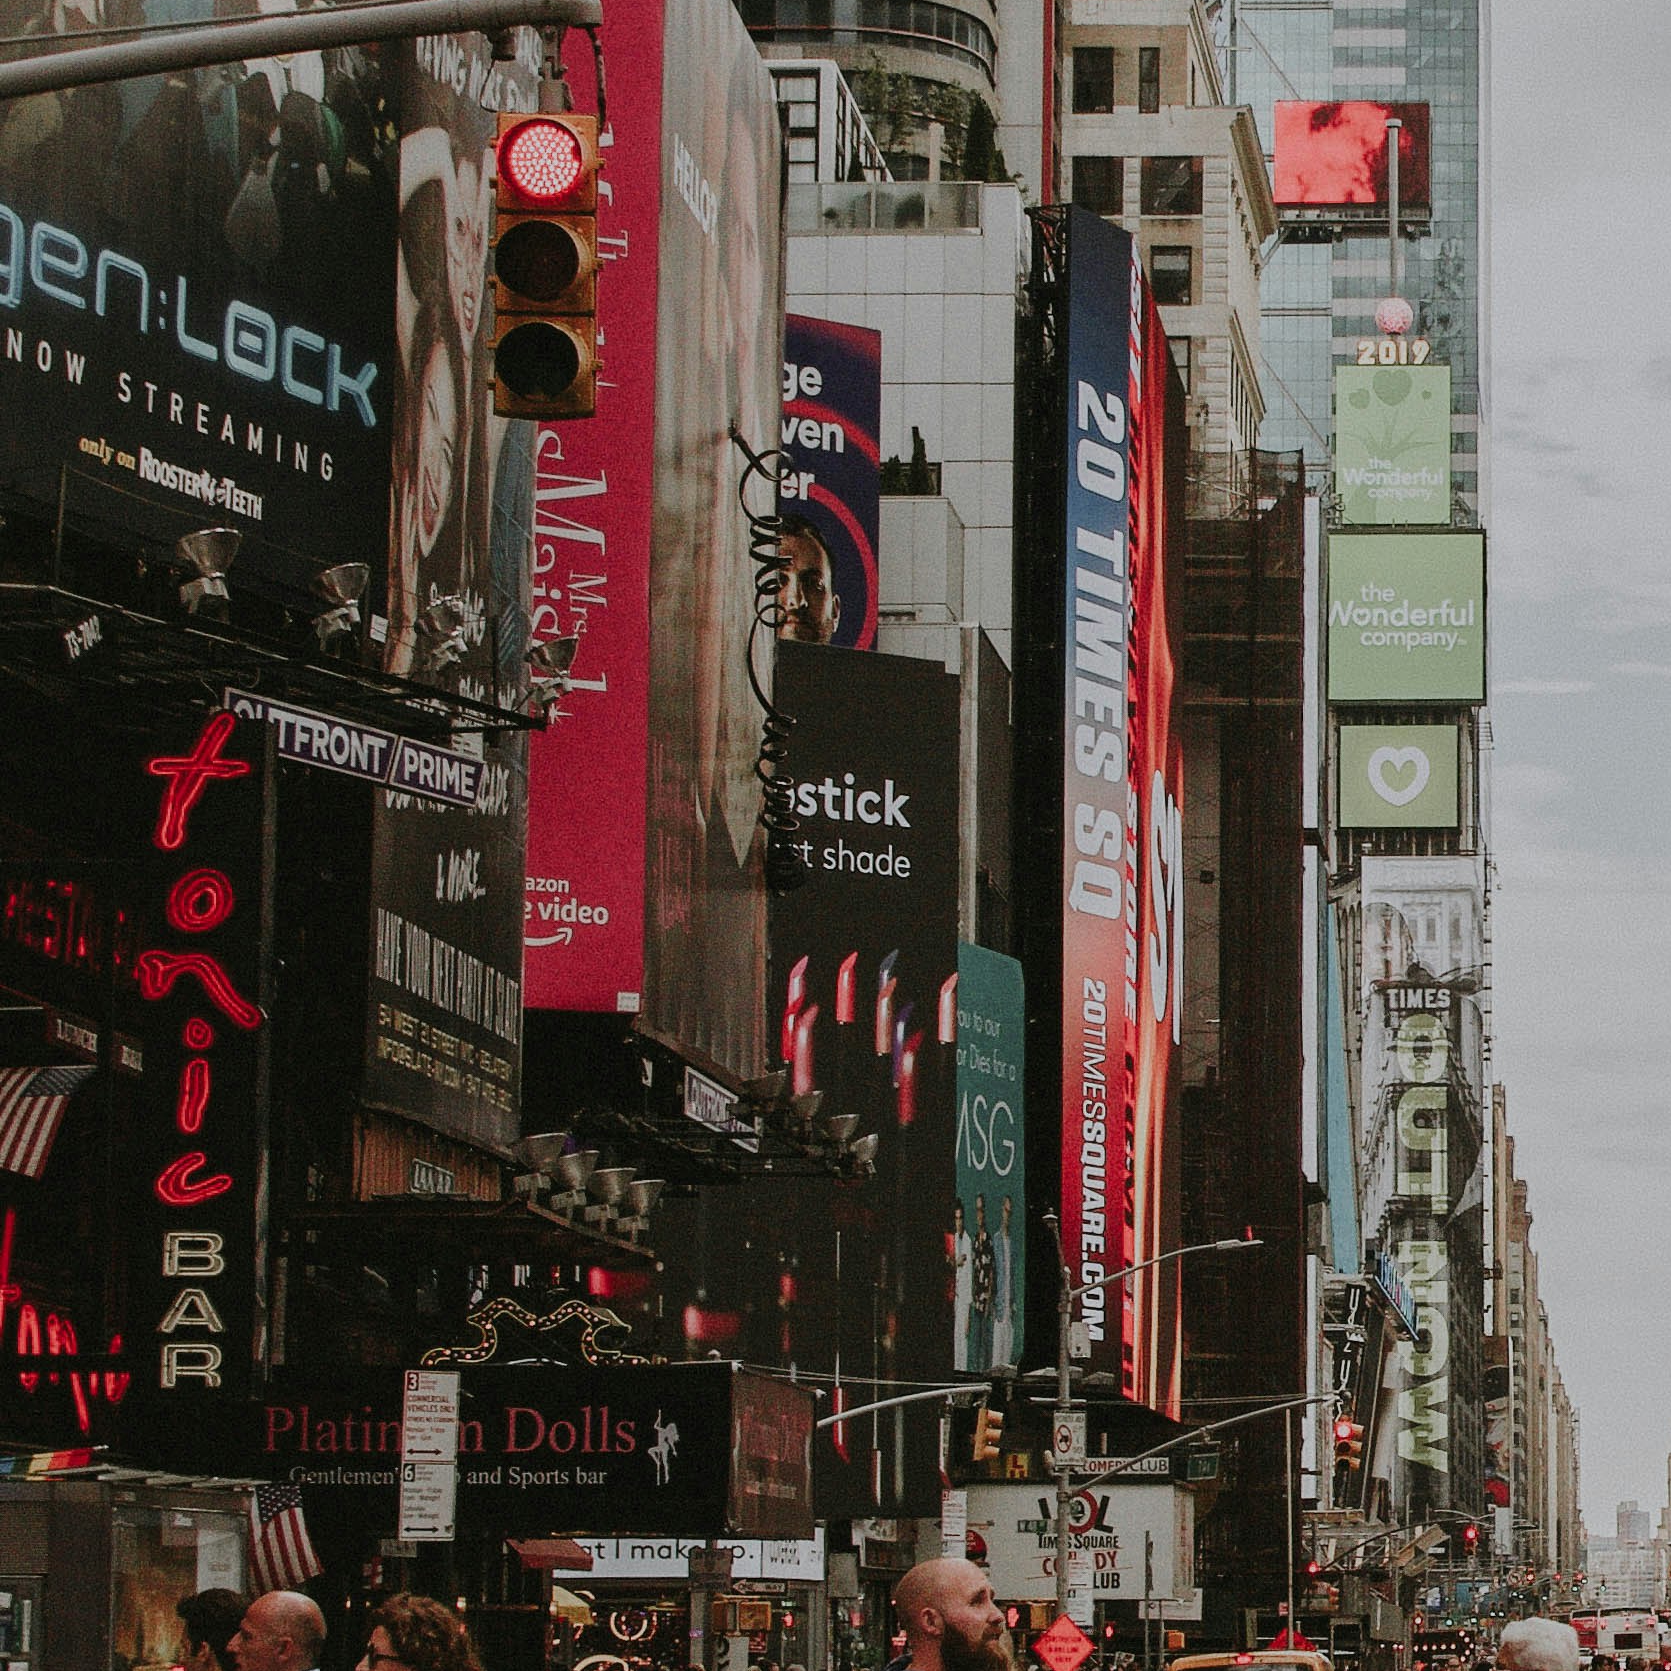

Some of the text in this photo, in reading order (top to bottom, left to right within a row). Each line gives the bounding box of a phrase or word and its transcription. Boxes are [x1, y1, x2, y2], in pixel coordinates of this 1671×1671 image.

[1357, 338, 1431, 365] 2019
[784, 359, 823, 399] ge
[6, 328, 334, 481] NOW STREAMING
[780, 419, 845, 453] ven
[1367, 456, 1392, 471] the
[78, 437, 263, 520] only on ROOSTER TEETH
[780, 470, 815, 499] er
[1343, 466, 1444, 487] Wonderful
[1367, 487, 1433, 502] company
[531, 469, 608, 692] Maisl
[1361, 584, 1396, 603] the
[1328, 600, 1475, 628] Wonderful
[1068, 380, 1126, 920] 20 TIMES SQ
[1360, 629, 1459, 652] company
[233, 698, 476, 799] TFRONT PRIME
[788, 772, 912, 828] stick
[823, 838, 912, 878] shade
[525, 876, 570, 894] azon
[537, 896, 610, 925] video
[1387, 988, 1451, 1009] TIMES
[1080, 977, 1108, 1343] 20TIMESSQUARE.COM
[156, 1230, 227, 1389] BAR
[407, 1372, 419, 1390] 3
[407, 1395, 450, 1403] COMMERCIAL
[407, 1404, 456, 1413] VEHICLES ONLY
[263, 1404, 637, 1455] Platinm Dolls
[289, 1465, 607, 1490] Gentlemen' and Sports bar
[404, 1464, 415, 1482] 6
[1131, 1458, 1168, 1473] CLUB
[630, 1539, 693, 1560] mak
[1037, 1534, 1119, 1550] TIMS SQUARE
[1042, 1551, 1118, 1576] CDY
[1093, 1572, 1121, 1589] LUB
